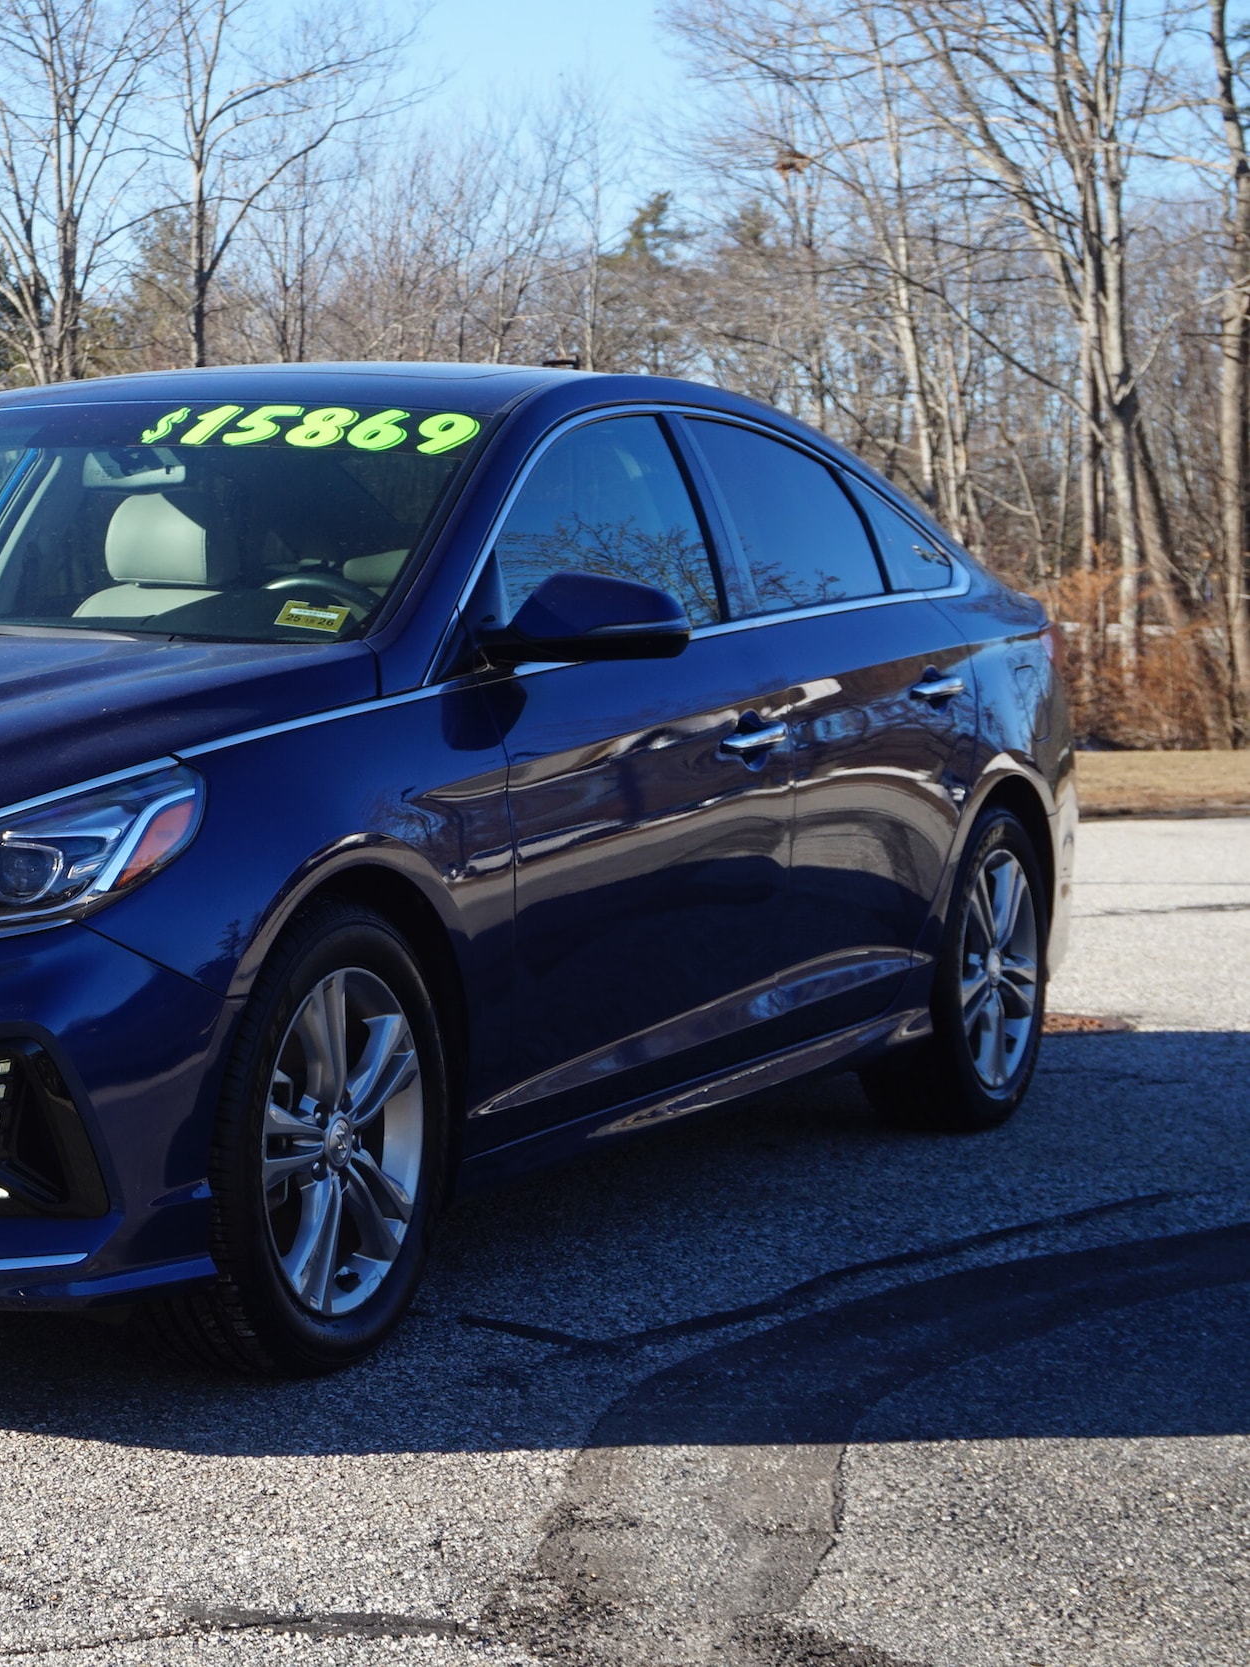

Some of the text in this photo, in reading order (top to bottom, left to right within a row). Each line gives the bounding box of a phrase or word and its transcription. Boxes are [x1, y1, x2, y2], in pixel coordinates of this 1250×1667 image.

[141, 404, 482, 455] $15869
[285, 614, 301, 622] 25
[317, 618, 334, 626] 26
